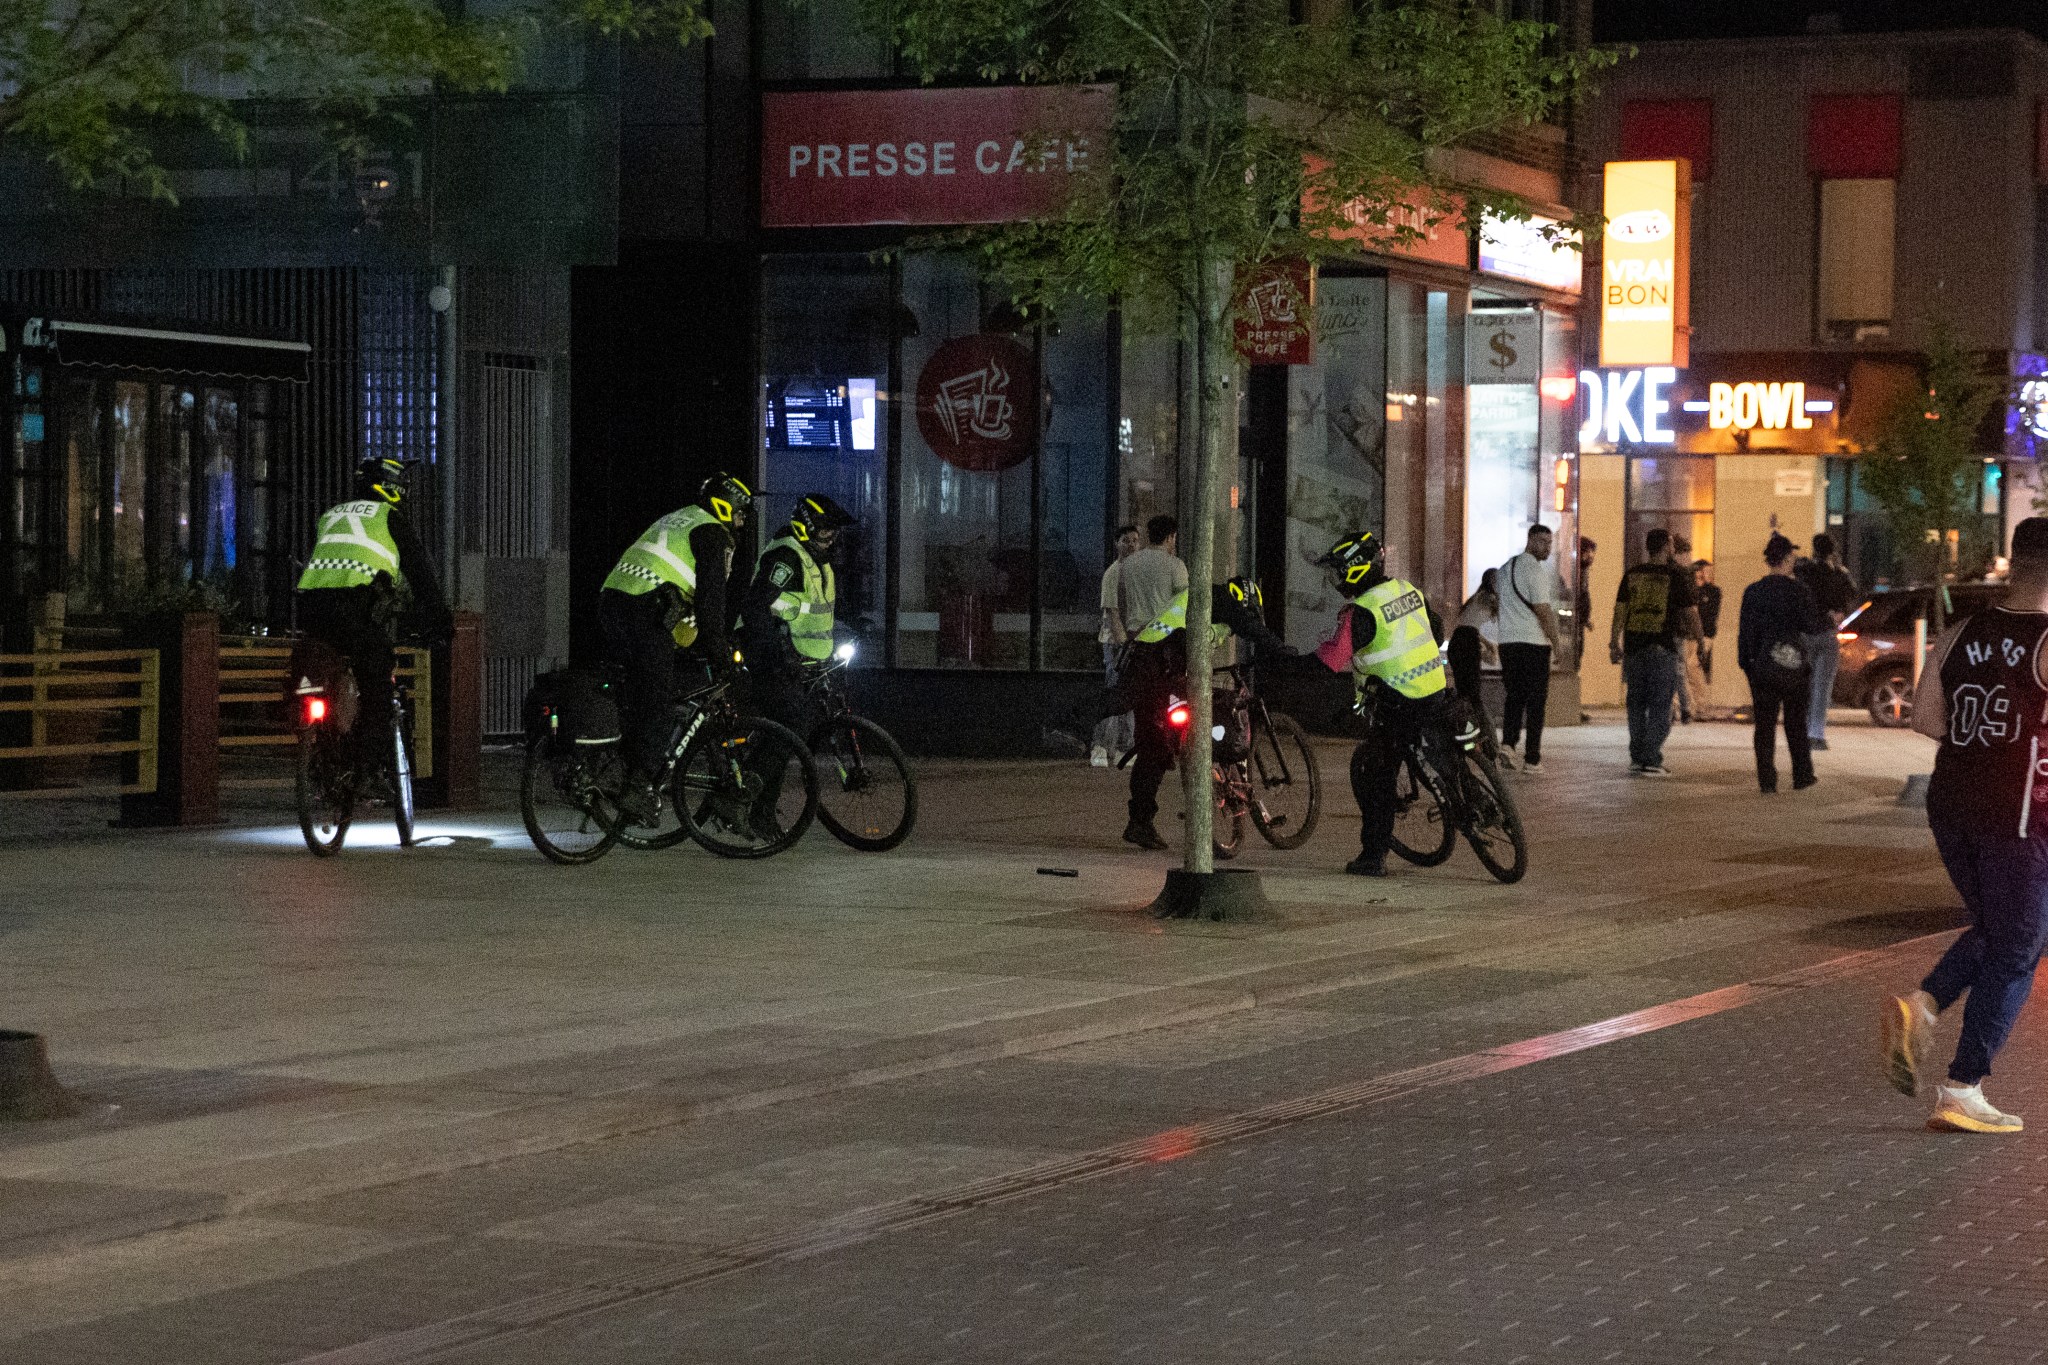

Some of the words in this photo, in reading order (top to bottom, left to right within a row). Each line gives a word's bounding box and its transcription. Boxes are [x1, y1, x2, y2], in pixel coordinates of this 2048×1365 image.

[788, 141, 956, 178] PRESSE
[1606, 258, 1672, 282] VRAI
[1608, 284, 1668, 305] BON
[333, 503, 375, 516] OLICE
[1383, 593, 1421, 620] POLICE
